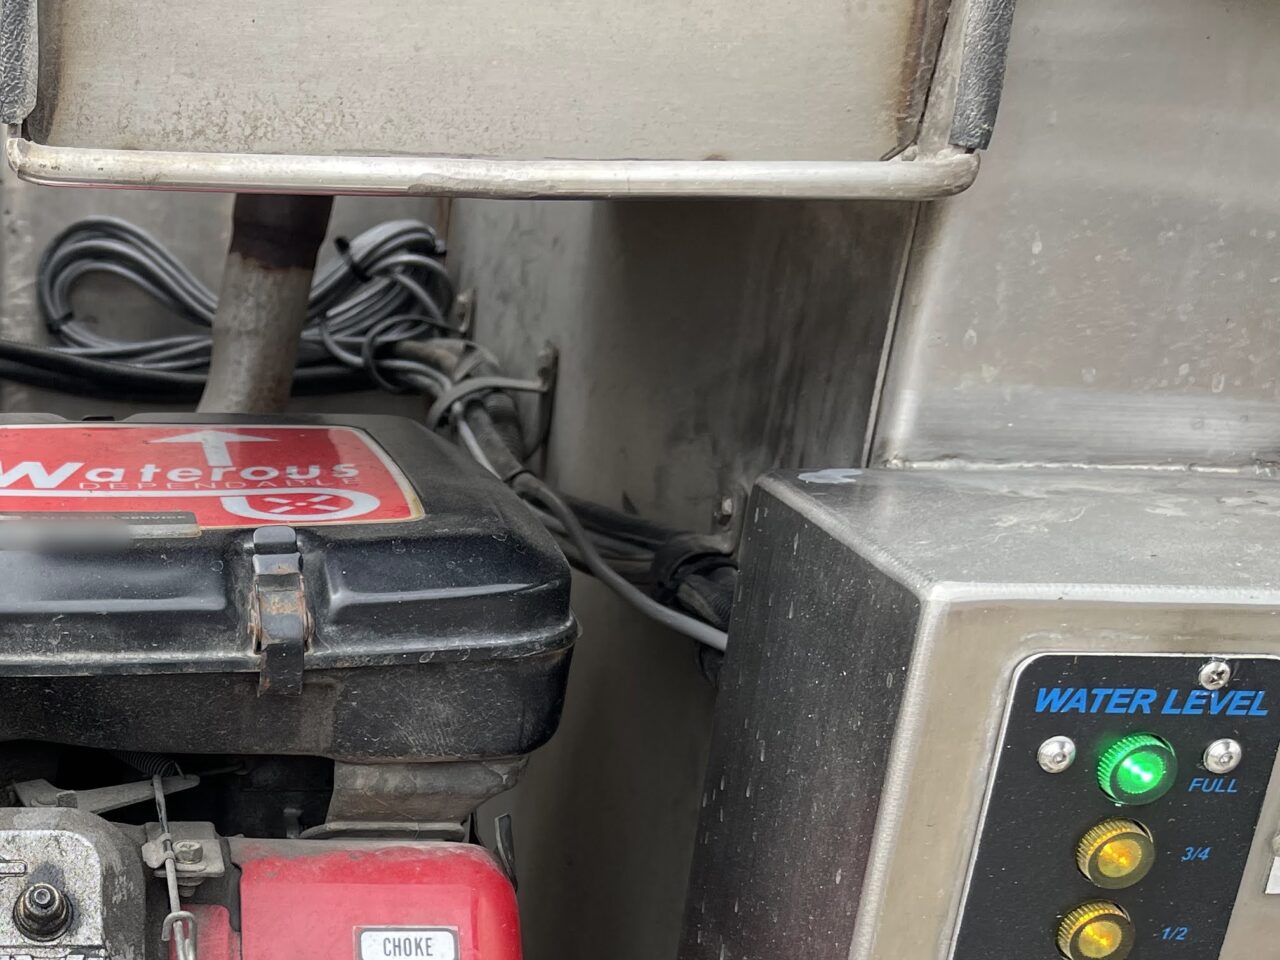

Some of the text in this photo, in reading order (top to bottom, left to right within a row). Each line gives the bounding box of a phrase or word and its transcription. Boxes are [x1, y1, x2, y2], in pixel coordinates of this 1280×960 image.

[1035, 687, 1269, 716] WATER LEVEL
[1188, 777, 1238, 793] FULL
[1181, 847, 1211, 862] 3/4
[1161, 926, 1188, 941] 1/2
[383, 937, 433, 957] CHOKE
